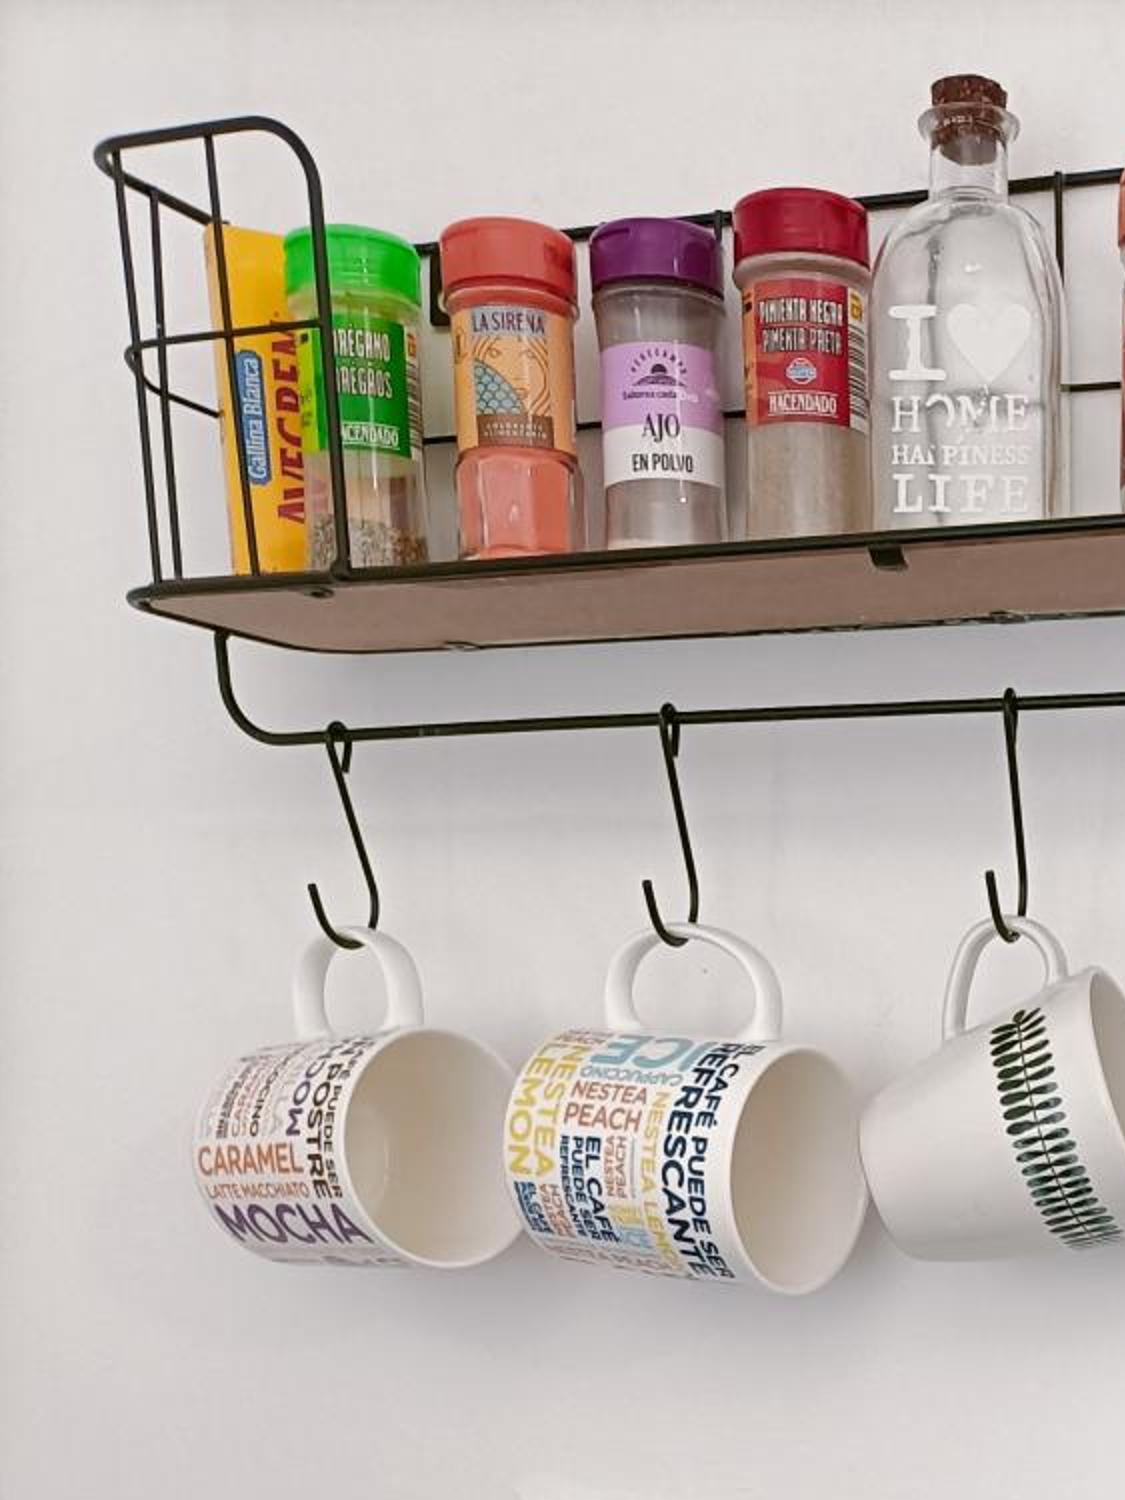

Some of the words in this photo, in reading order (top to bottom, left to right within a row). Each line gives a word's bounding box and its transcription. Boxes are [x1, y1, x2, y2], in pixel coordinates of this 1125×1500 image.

[473, 311, 489, 333] LA
[888, 304, 947, 381] I
[768, 392, 838, 415] HACENDADO
[341, 424, 400, 447] ACENDADO
[641, 412, 681, 443] AJO
[631, 453, 649, 473] EN
[651, 453, 694, 473] POLVO
[891, 473, 1030, 513] LIFE
[509, 1042, 568, 1175] LEMON
[532, 1043, 592, 1178] NESTEA
[570, 1081, 648, 1105] NESTEA
[694, 1063, 740, 1129] CAFÉ
[306, 1063, 344, 1199] POSTRE
[563, 1101, 643, 1133] PEACH
[198, 1142, 305, 1177] CARAMEL
[571, 1136, 587, 1202] PUEDE
[584, 1135, 602, 1169] EL
[661, 1043, 742, 1277] REFRESCANTE
[687, 1135, 712, 1235] PUEDE
[213, 1203, 375, 1244] MOCHA
[578, 1207, 602, 1241] SER
[586, 1177, 621, 1244] CAFÉ
[699, 1239, 736, 1279] SER
